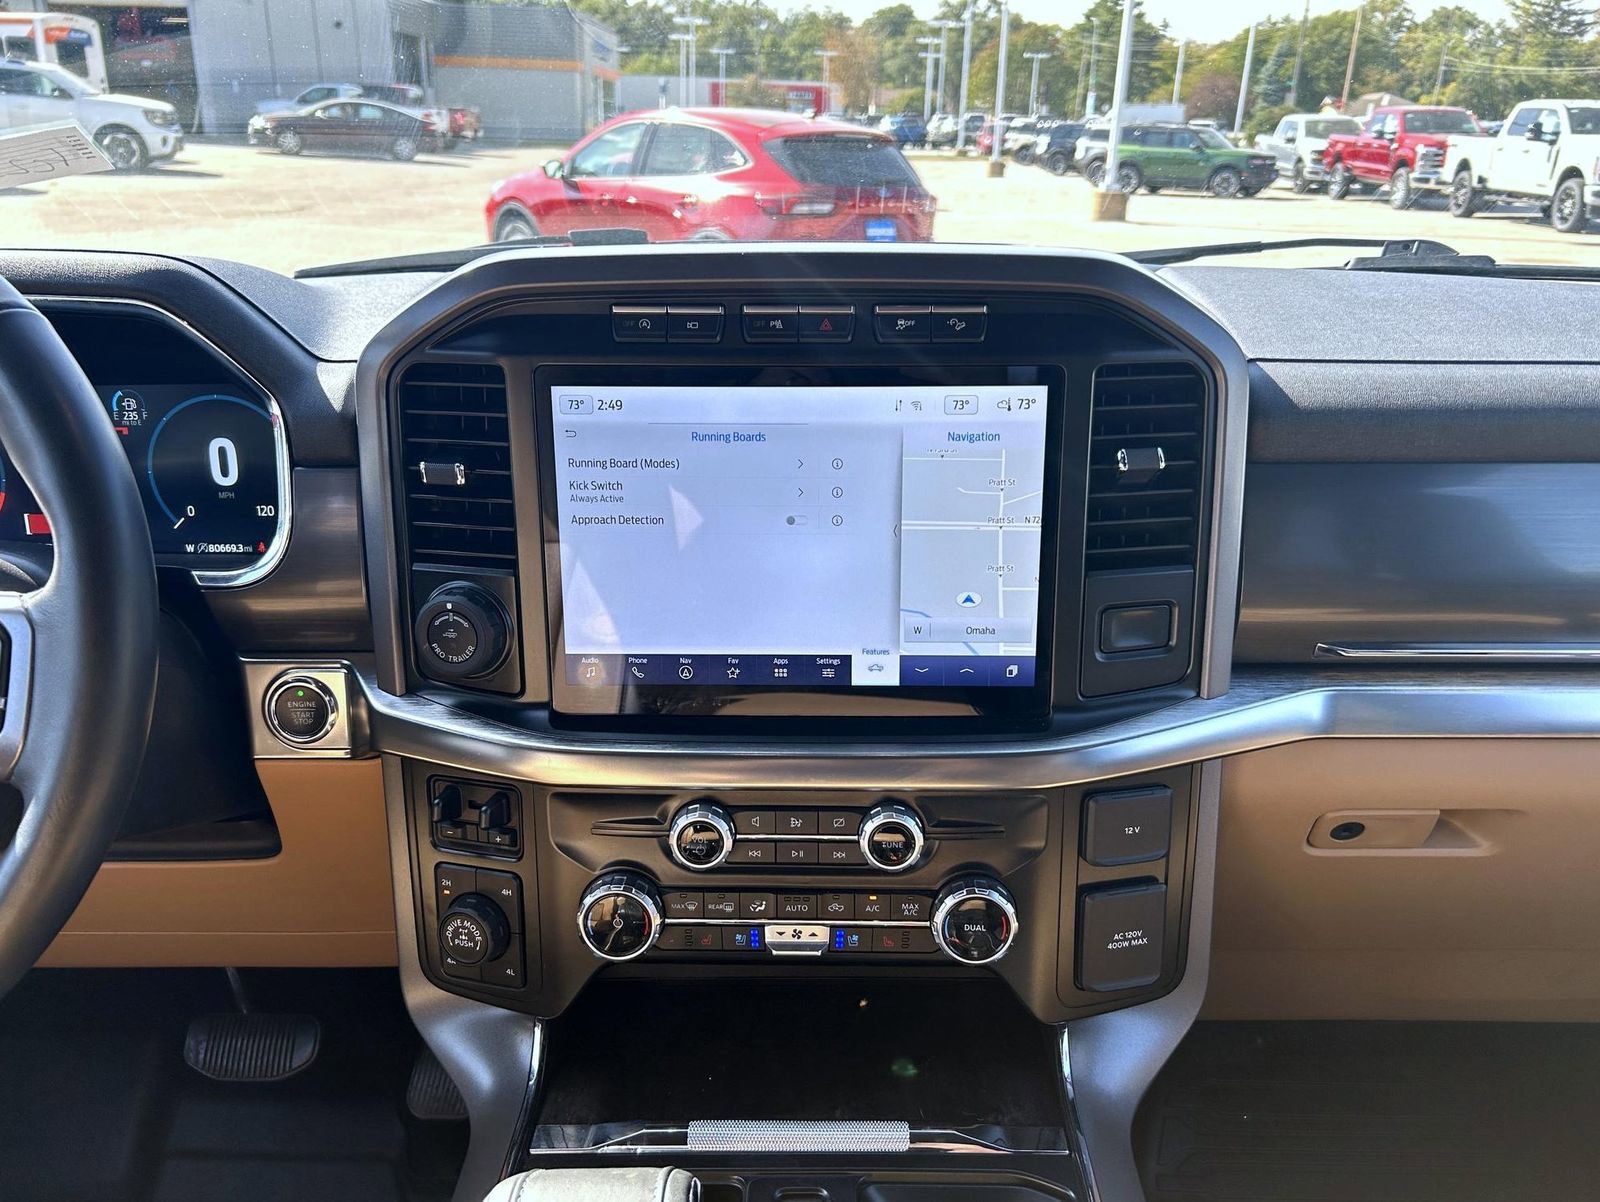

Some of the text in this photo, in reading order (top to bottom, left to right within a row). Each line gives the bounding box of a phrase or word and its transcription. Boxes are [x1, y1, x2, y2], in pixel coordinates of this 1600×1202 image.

[567, 400, 585, 410] 73°
[597, 399, 623, 411] 2:49
[952, 399, 970, 411] 73°
[1017, 398, 1037, 410] 73°
[113, 411, 120, 420] E
[122, 411, 139, 421] 235
[142, 411, 148, 420] F
[691, 431, 766, 444] Running Boards
[947, 431, 1001, 444] Navigation
[208, 437, 239, 487] 0
[568, 458, 680, 470] Running Board (Modes)
[569, 480, 623, 491] Kick Switch
[988, 478, 1016, 487] Pratt St
[218, 491, 235, 500] MPH
[570, 494, 624, 504] Always Active
[187, 505, 196, 517] 0
[256, 505, 275, 517] 120
[571, 514, 664, 526] Approach Detection
[987, 516, 1015, 525] Pratt St
[1024, 516, 1031, 524] N
[185, 544, 195, 553] W
[987, 564, 1014, 573] Pratt St
[913, 626, 923, 635] W
[965, 625, 996, 635] Omaha
[431, 643, 475, 663] PRO TRAILER
[861, 648, 890, 656] Features
[727, 657, 740, 665] Fav
[772, 657, 789, 665] Apps
[816, 657, 841, 666] Settings
[1135, 826, 1141, 834] V
[441, 879, 452, 887] 2H
[501, 888, 512, 896] 4H
[785, 904, 808, 913] AUTO
[865, 904, 880, 912] A/C
[903, 908, 918, 916] A/C
[446, 919, 482, 942] DRIVE MODE
[964, 922, 986, 932] DUAL
[1113, 930, 1143, 940] AC 120V
[454, 938, 474, 948] PUSH
[1107, 936, 1148, 950] 400W MAX
[505, 968, 516, 976] 4L
